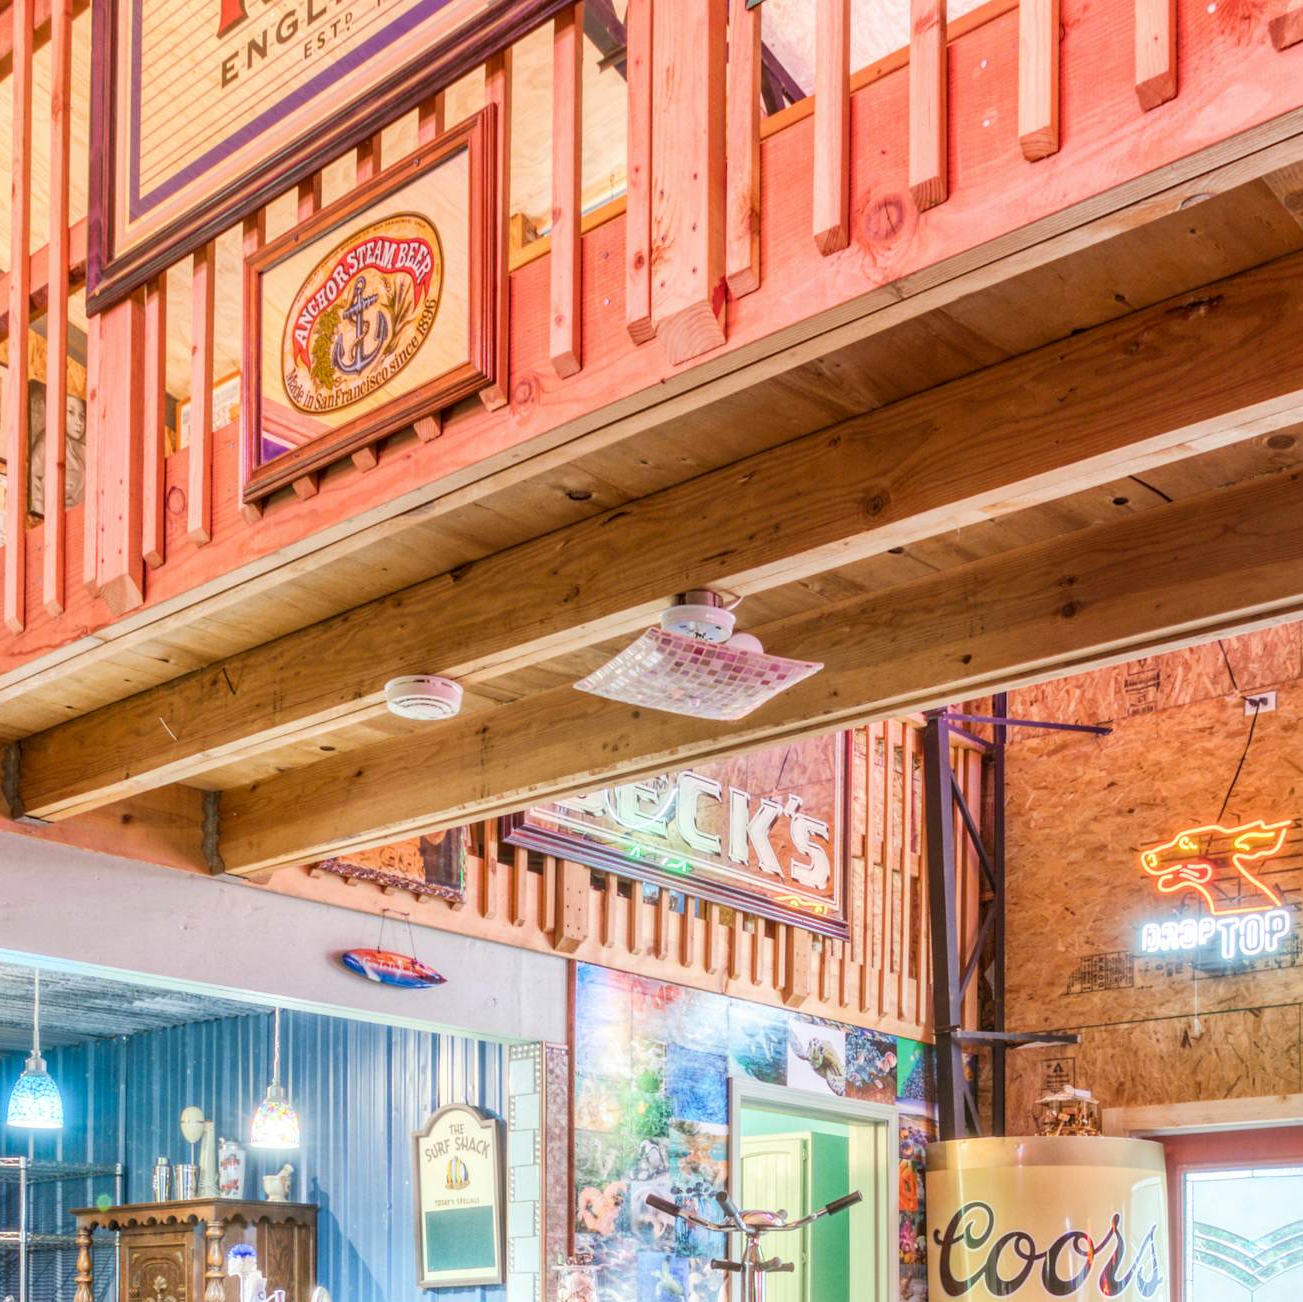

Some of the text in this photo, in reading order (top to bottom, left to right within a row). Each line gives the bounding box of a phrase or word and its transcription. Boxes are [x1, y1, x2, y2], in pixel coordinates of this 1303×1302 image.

[221, 0, 330, 89] ENGL
[294, 264, 350, 349] ANCHOR
[346, 240, 398, 274] STEAM
[397, 241, 432, 284] BEER
[285, 367, 305, 401] Made
[305, 394, 315, 410] in
[333, 366, 389, 407] Francisco
[389, 337, 420, 375] since
[415, 297, 438, 338] 1896
[560, 769, 831, 891] ECK'S
[1141, 917, 1217, 953] DROP
[1216, 909, 1291, 960] TOP
[425, 1135, 491, 1163] SURF SHACK
[448, 1123, 465, 1135] THE
[933, 1200, 1164, 1300] Coors
